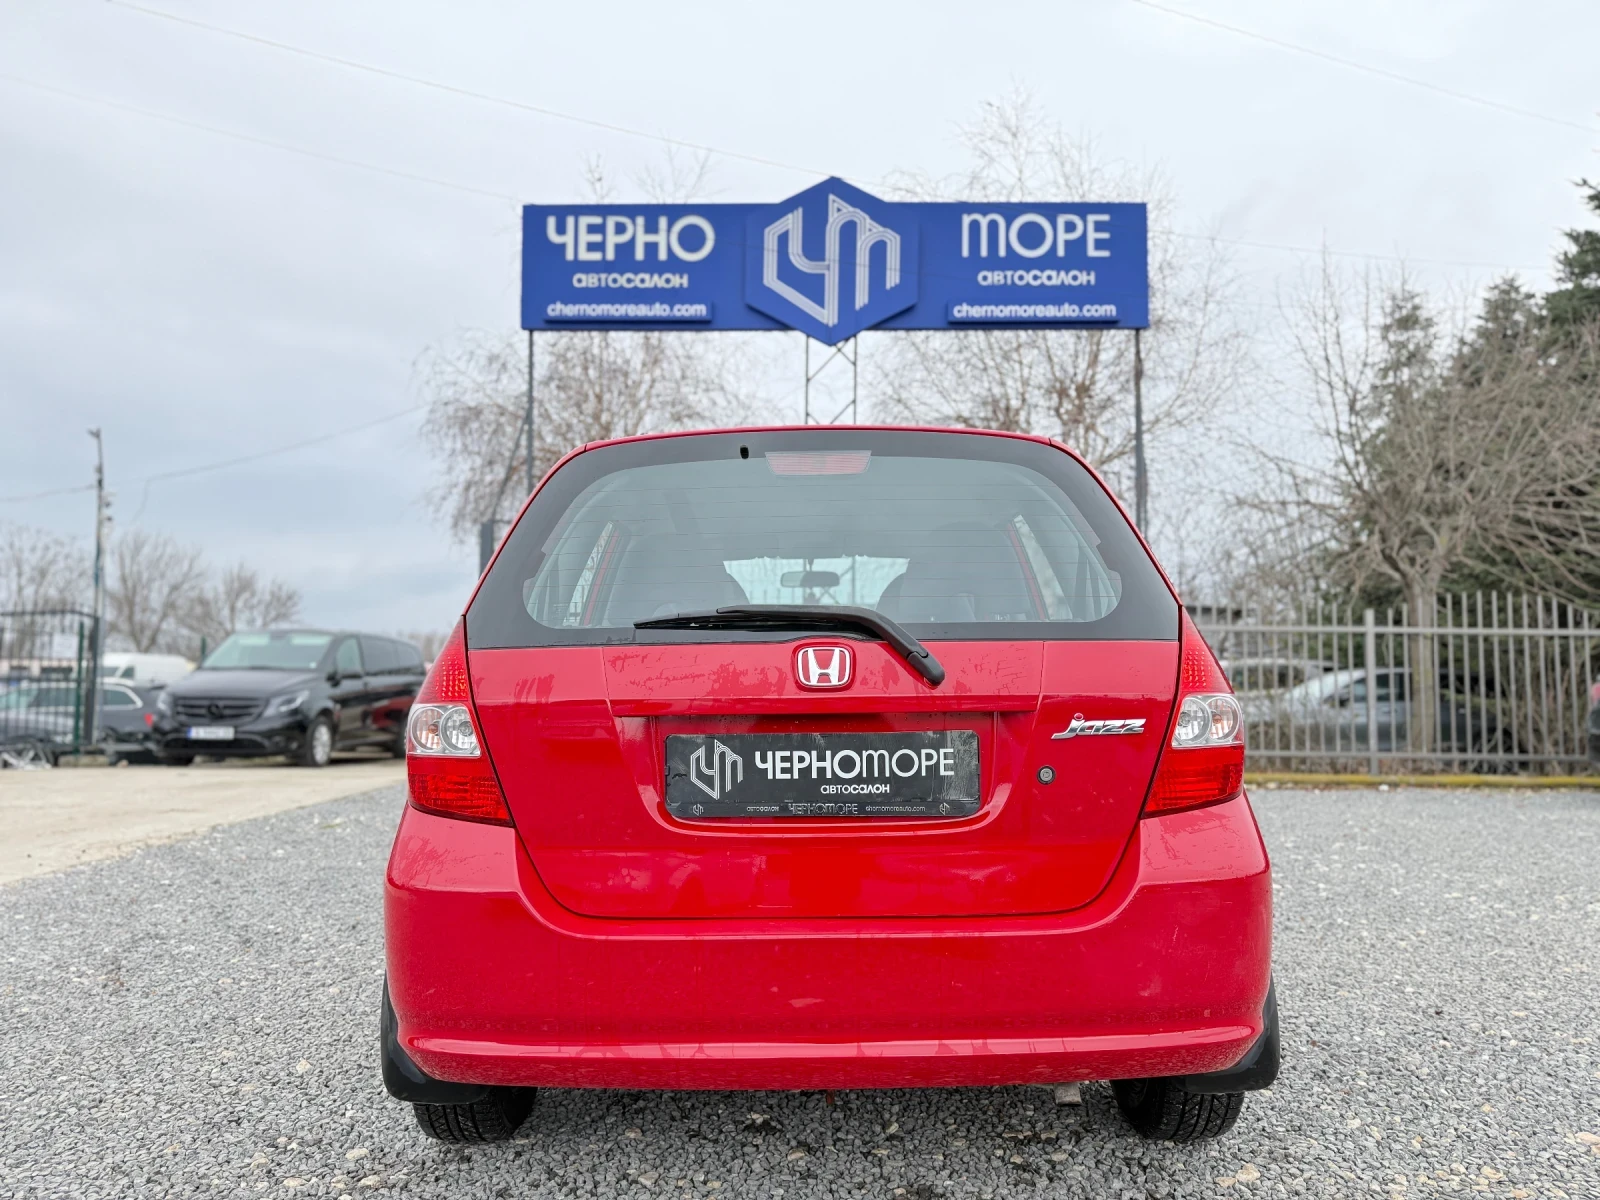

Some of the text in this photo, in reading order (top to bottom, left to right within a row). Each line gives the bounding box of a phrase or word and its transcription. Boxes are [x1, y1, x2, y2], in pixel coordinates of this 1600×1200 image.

[546, 214, 716, 262] ЧЕРНО
[547, 301, 708, 318] chernomoreauto.com
[953, 302, 1117, 319] chernomoreauto.com
